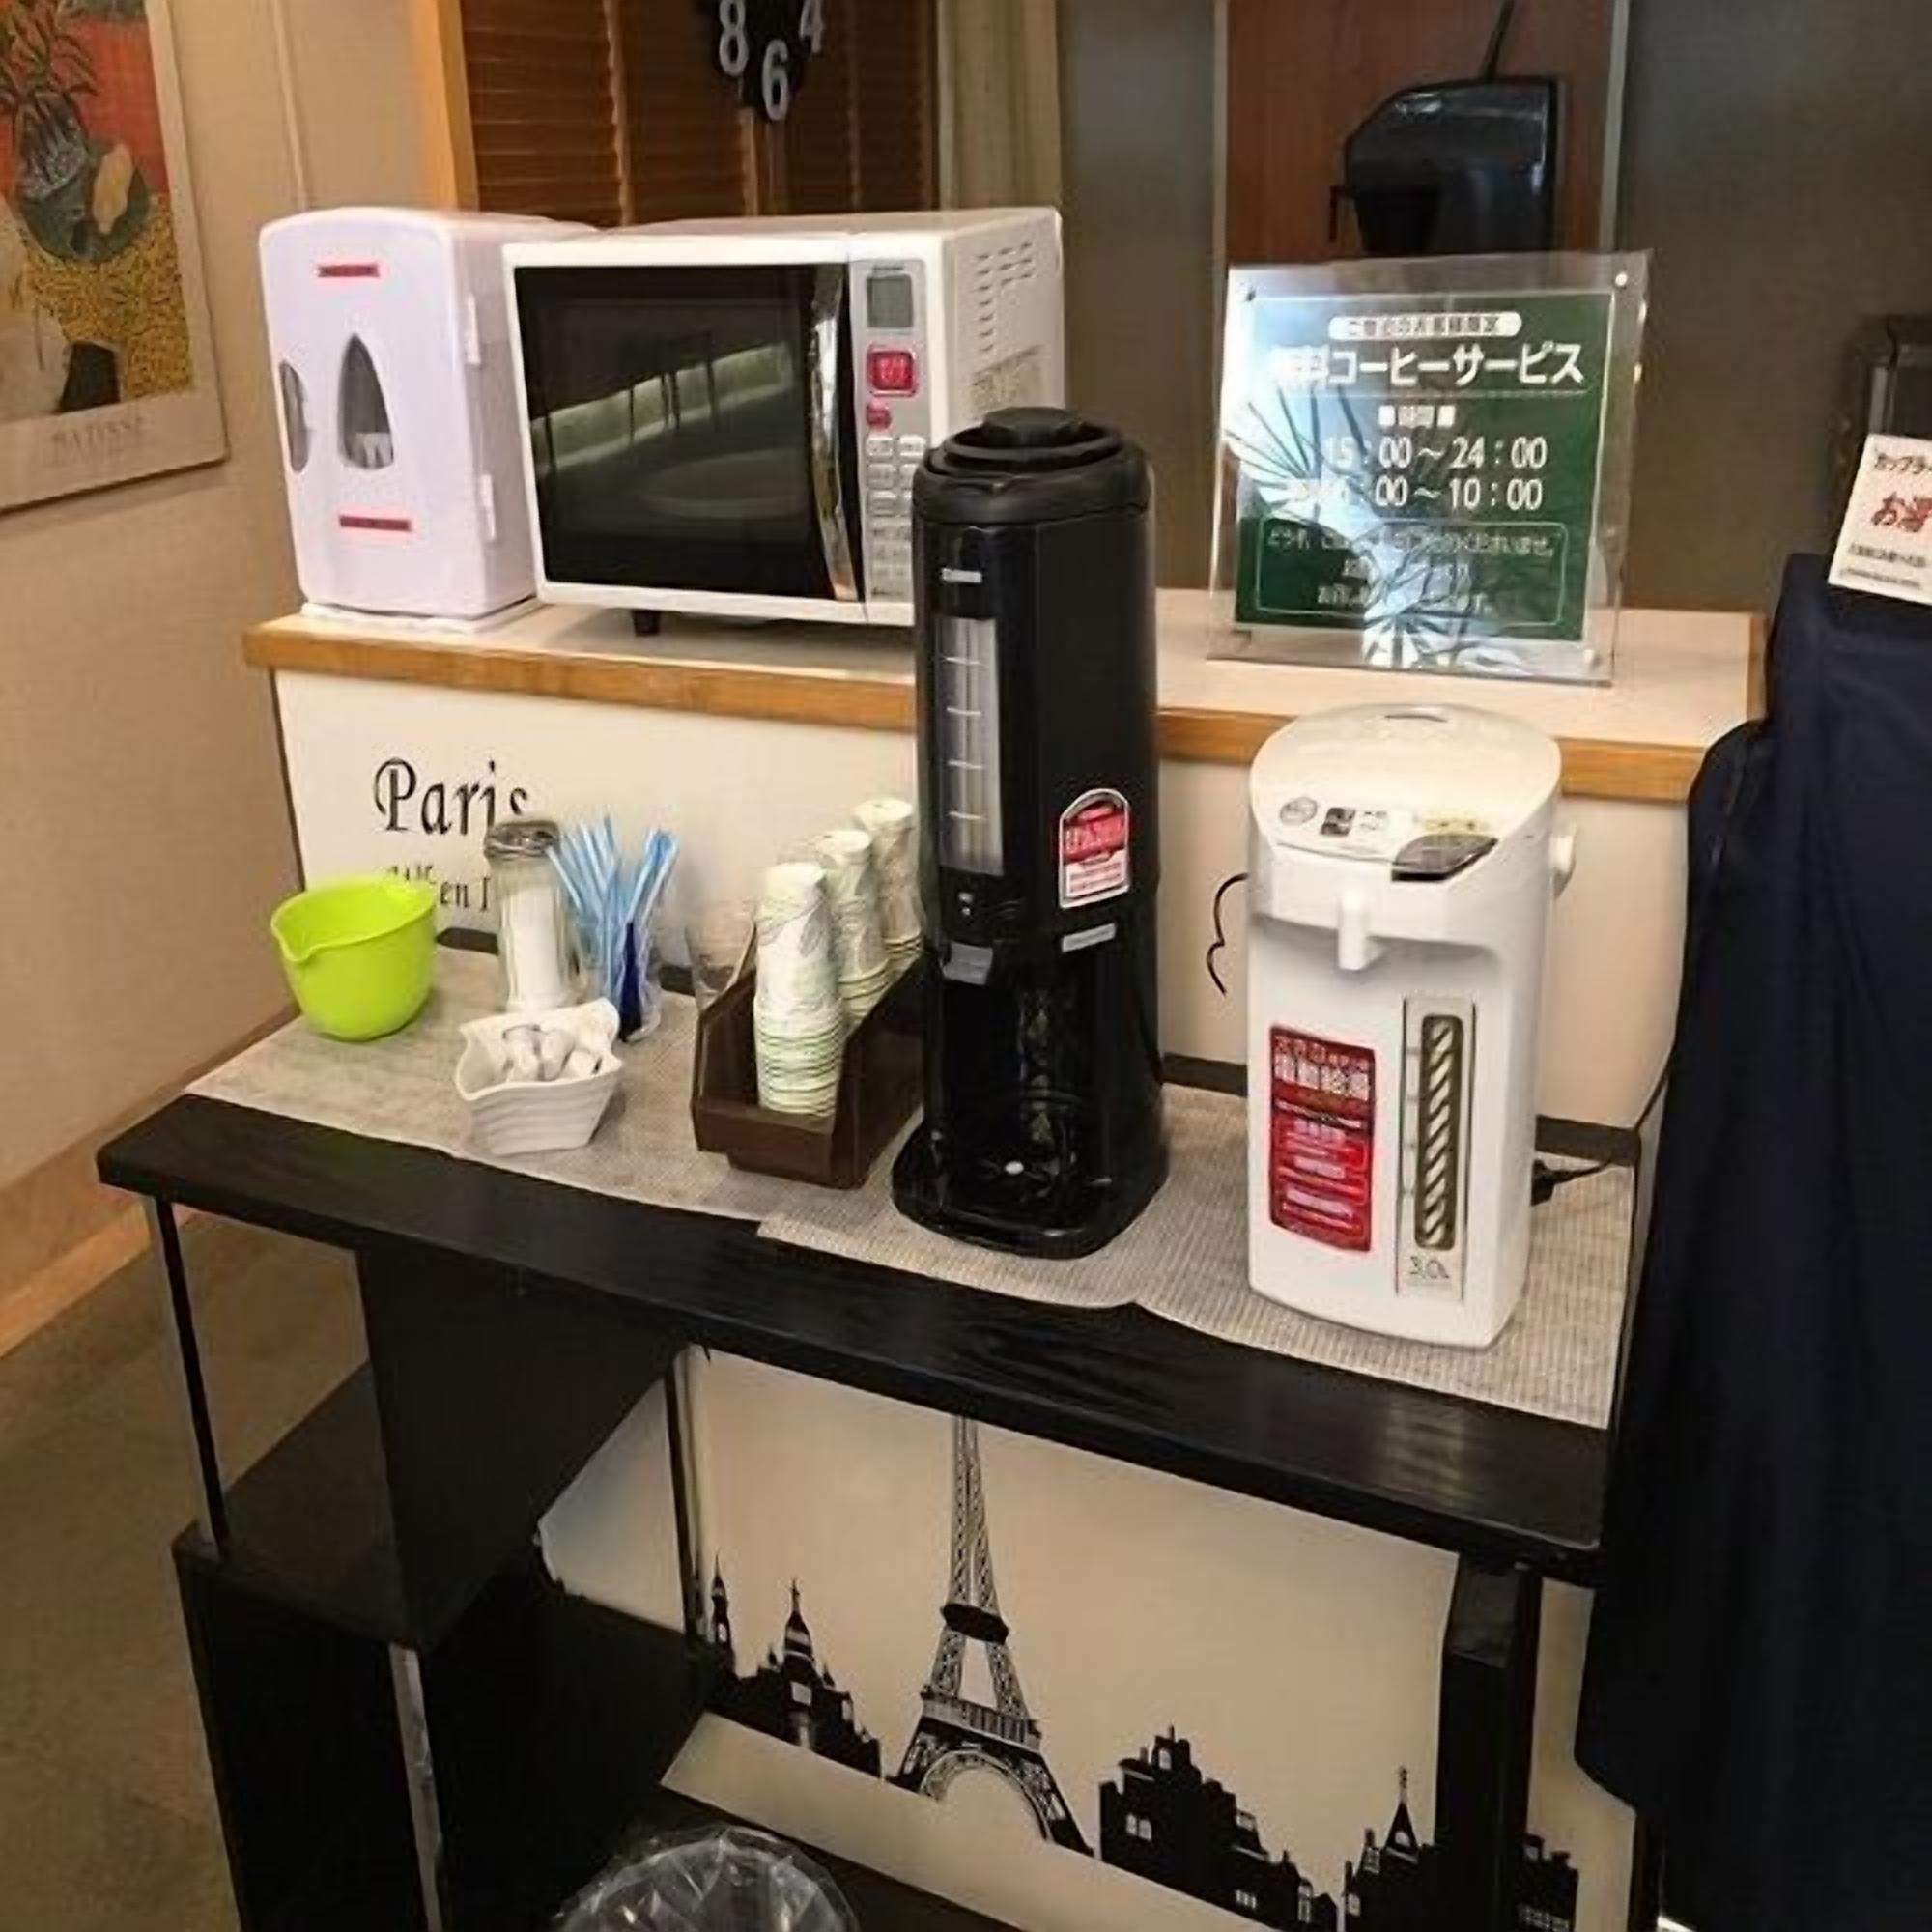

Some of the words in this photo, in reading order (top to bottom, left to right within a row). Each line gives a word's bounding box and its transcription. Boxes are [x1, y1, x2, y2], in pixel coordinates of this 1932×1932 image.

[719, 0, 749, 75] 8
[761, 39, 788, 121] 6
[374, 756, 528, 835] Paris
